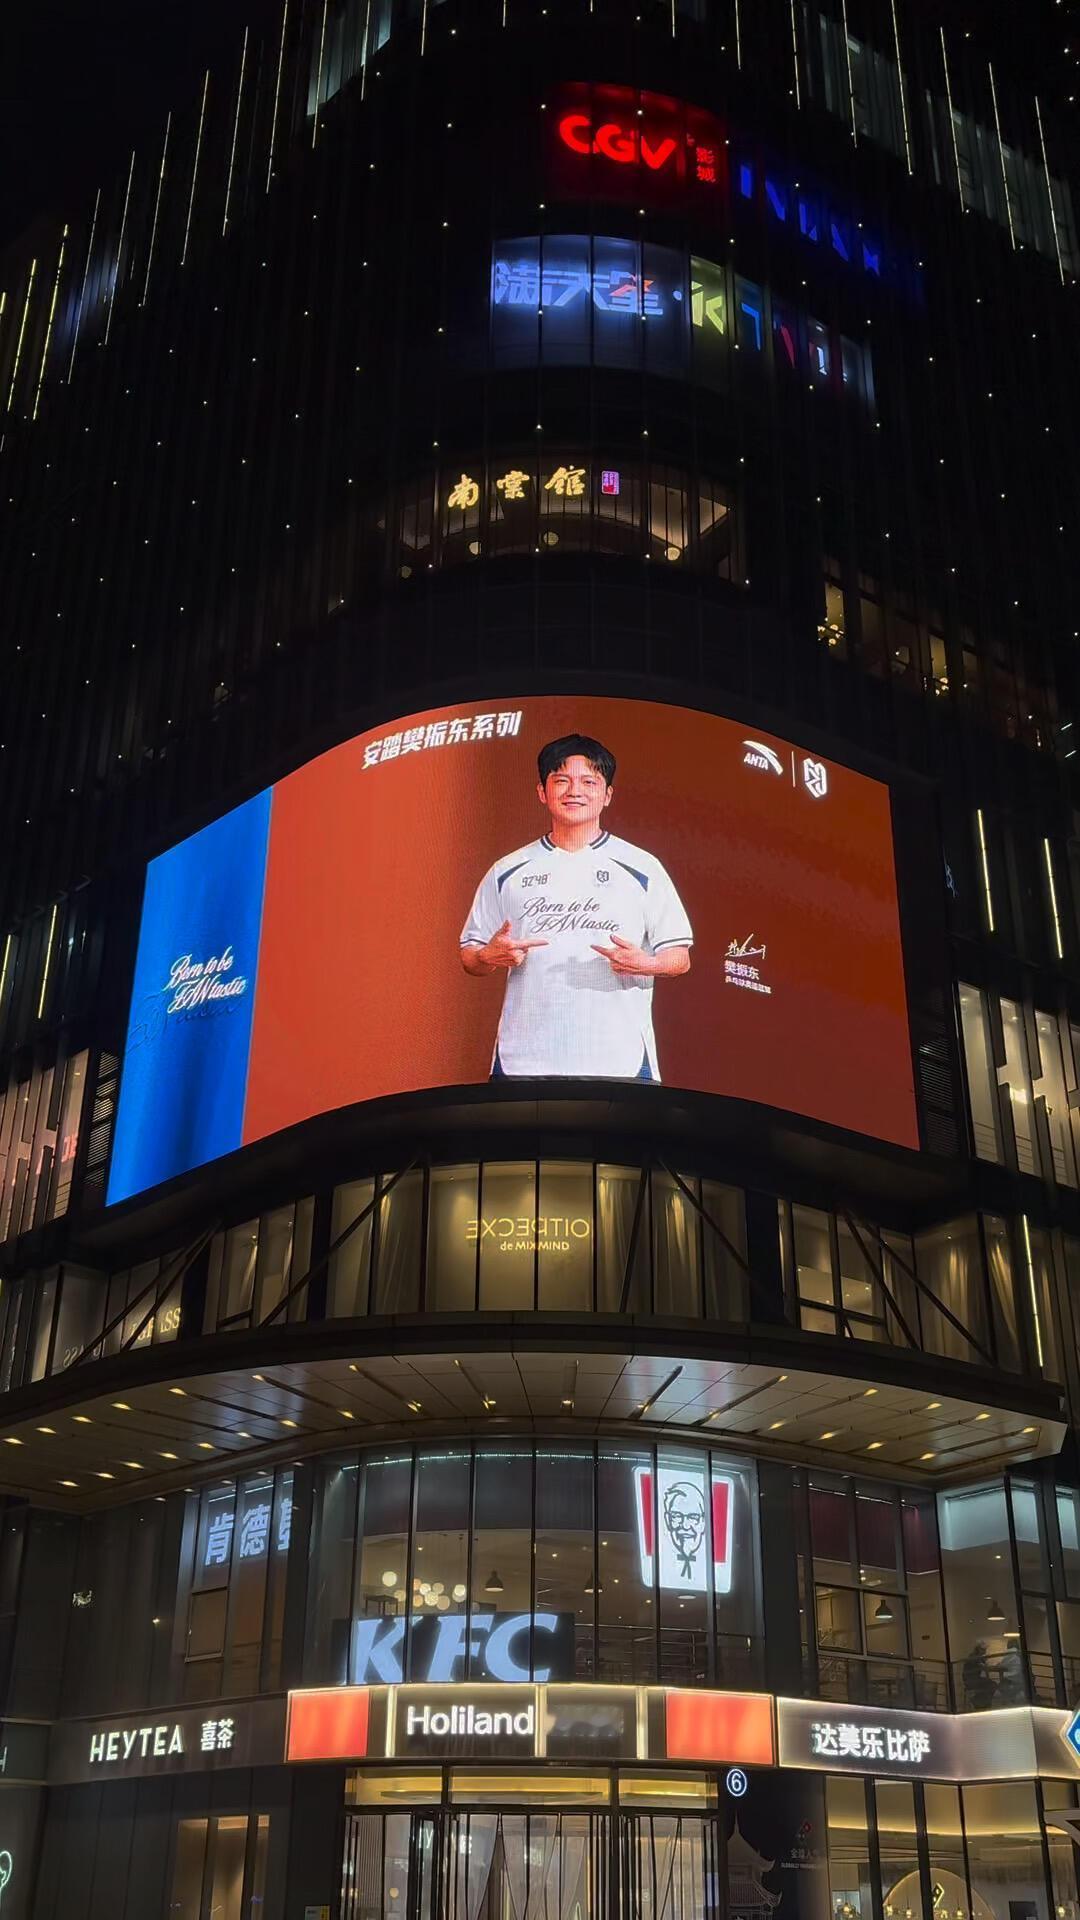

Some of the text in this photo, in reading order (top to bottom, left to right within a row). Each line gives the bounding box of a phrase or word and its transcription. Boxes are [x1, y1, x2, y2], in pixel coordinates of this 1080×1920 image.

[559, 115, 677, 170] CGV
[696, 147, 716, 182] 影城
[361, 711, 523, 770] 安踏樊振东系列
[743, 752, 769, 771] ANTA
[519, 896, 601, 920] Born to be
[530, 913, 621, 933] FANtastic
[162, 945, 234, 992] Born to be
[167, 974, 247, 1014] FANtastic
[500, 1241, 514, 1251] de
[353, 1613, 559, 1685] KFC
[89, 1718, 235, 1763] HEYTEA 喜茶
[406, 1705, 535, 1736] Holiland
[811, 1722, 932, 1763] 达美乐比萨
